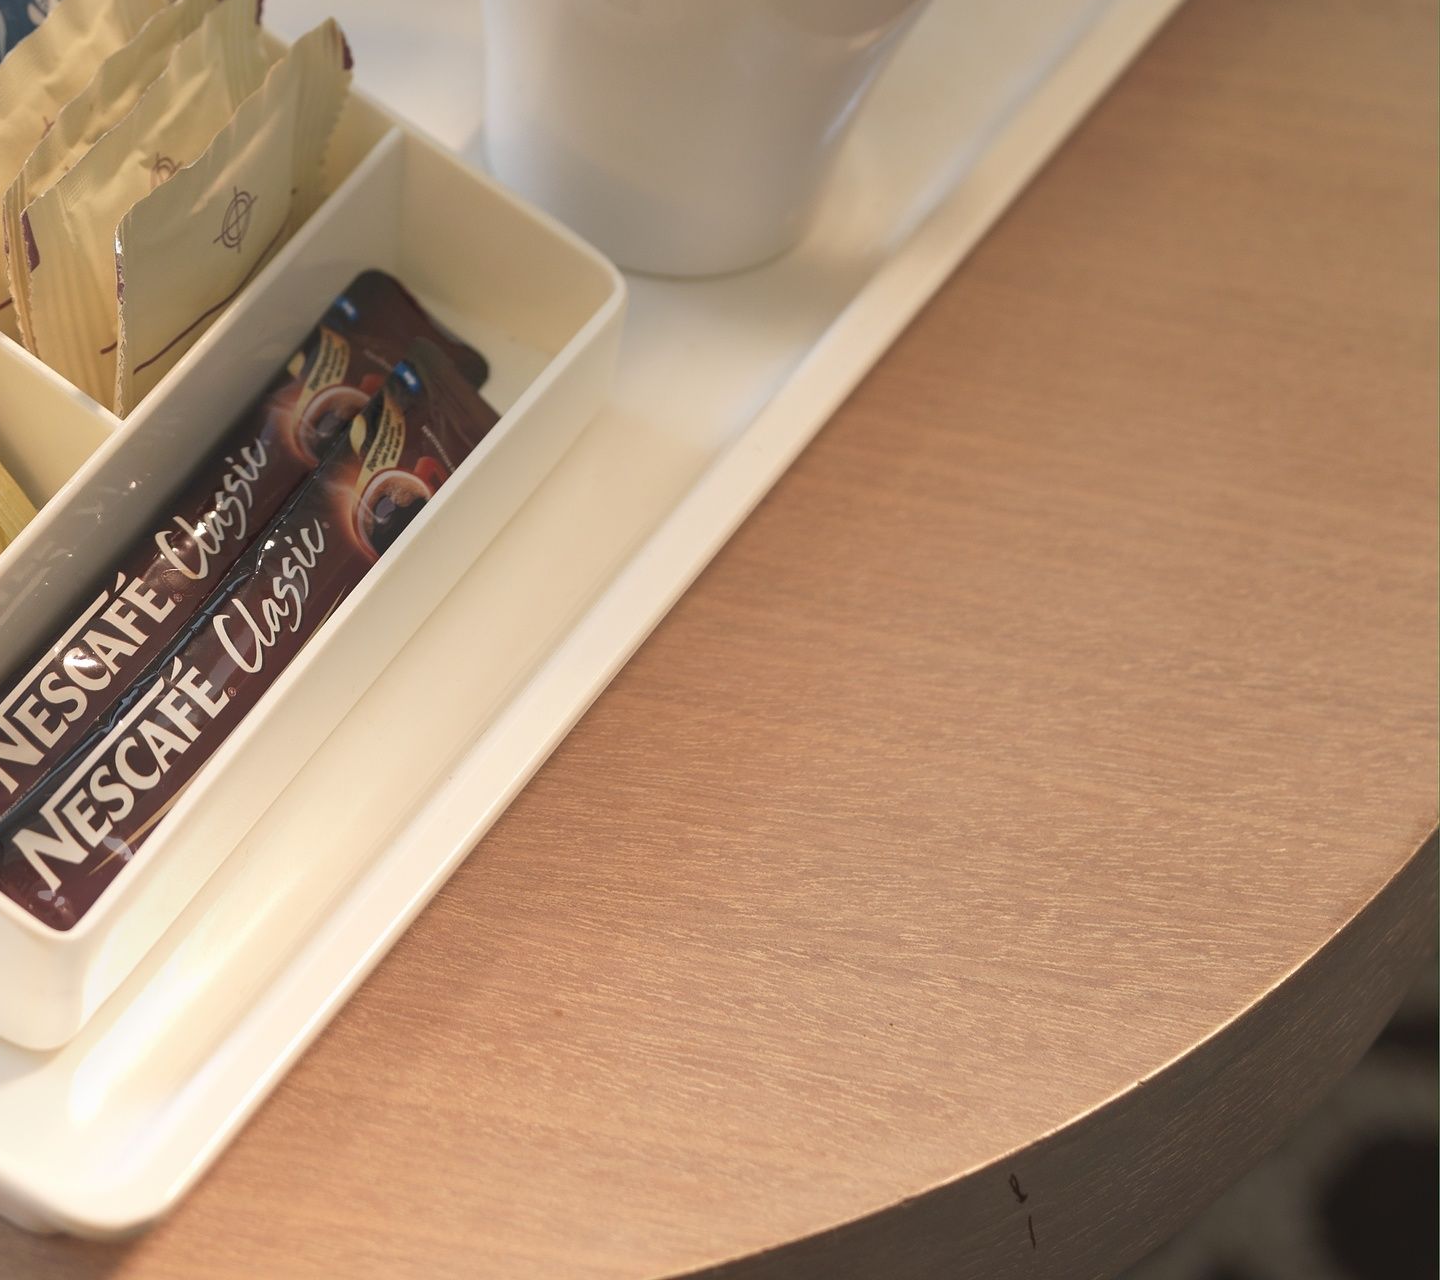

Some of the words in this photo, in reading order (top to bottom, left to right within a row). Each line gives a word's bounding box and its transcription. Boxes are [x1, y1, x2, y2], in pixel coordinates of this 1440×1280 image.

[154, 436, 270, 581] Classic
[9, 656, 233, 894] NESCAFÉ
[212, 517, 328, 676] Classic
